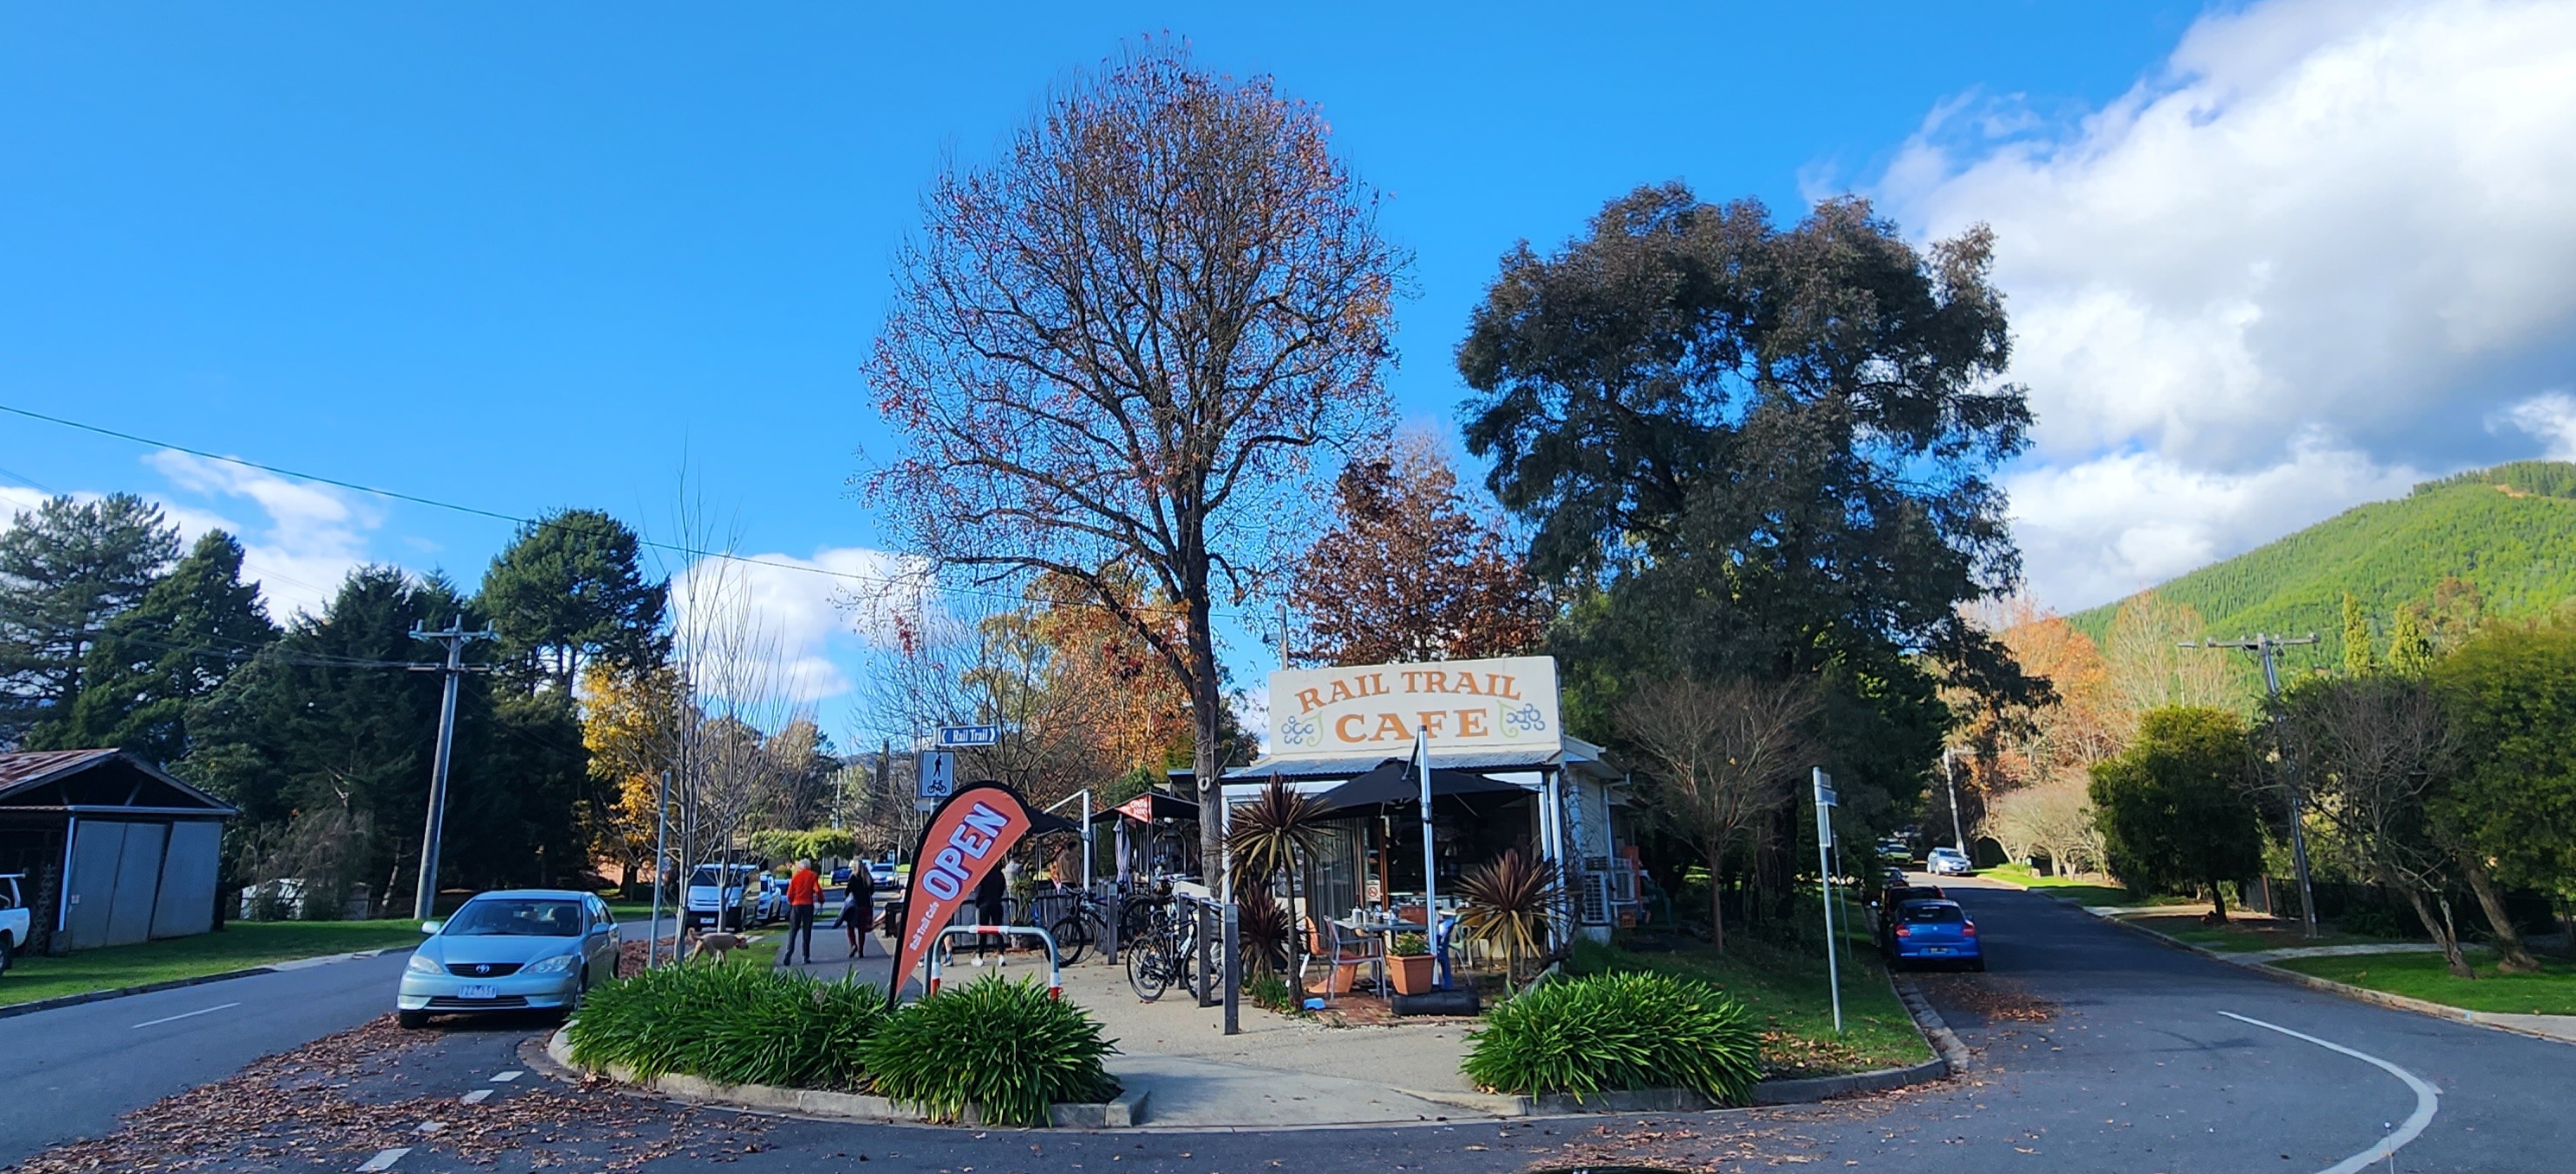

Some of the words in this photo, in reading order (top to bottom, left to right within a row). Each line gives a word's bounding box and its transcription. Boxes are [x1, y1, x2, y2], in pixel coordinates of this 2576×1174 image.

[1294, 672, 1390, 715] RAIL
[1400, 670, 1521, 701] TRAIL
[953, 729, 968, 742] Rail
[969, 728, 988, 741] Trail
[1335, 708, 1488, 743] CAFE
[922, 801, 1011, 901] OPEN
[910, 934, 923, 951] Rail
[917, 916, 931, 936] Trail
[925, 901, 940, 920] Cafe
